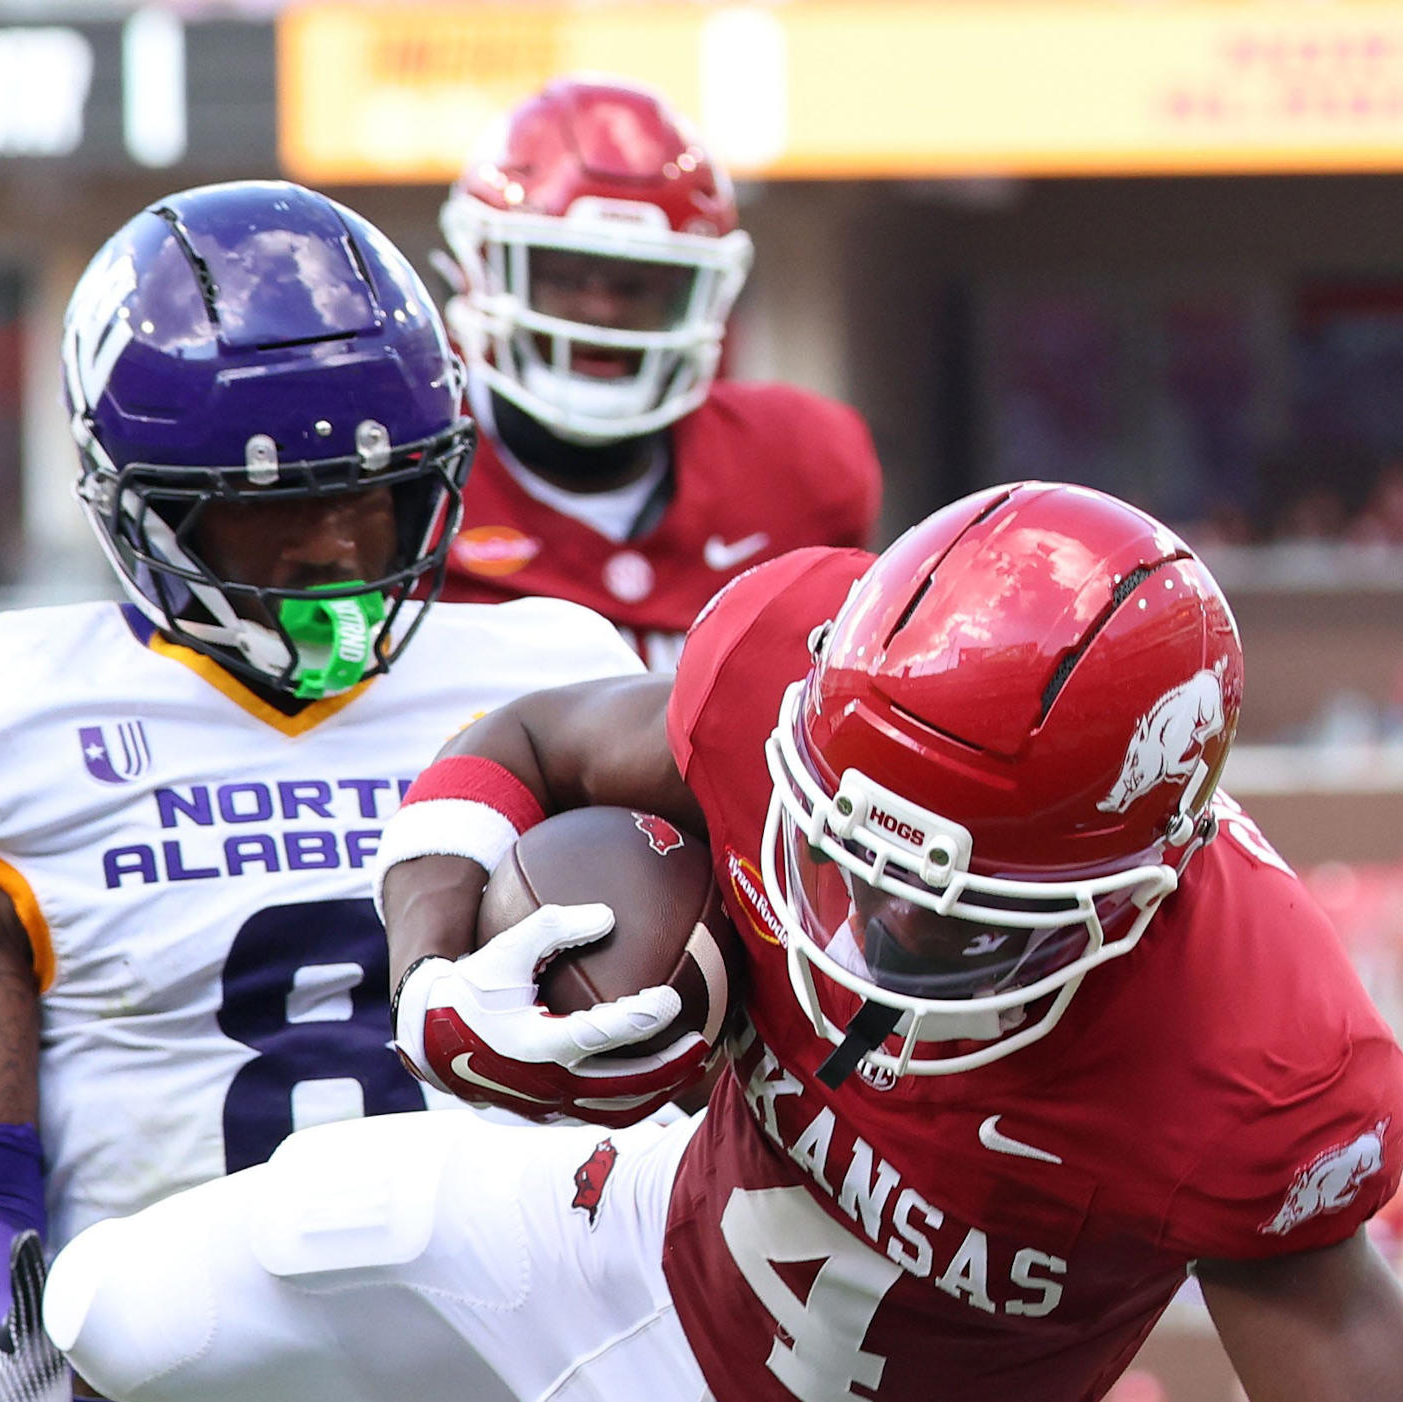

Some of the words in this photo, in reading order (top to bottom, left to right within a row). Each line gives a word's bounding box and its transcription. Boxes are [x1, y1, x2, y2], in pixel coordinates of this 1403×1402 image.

[154, 779, 413, 829] NORT
[869, 805, 926, 847] HOGS
[217, 897, 427, 1176] 8
[725, 1022, 1068, 1318] KANSAS
